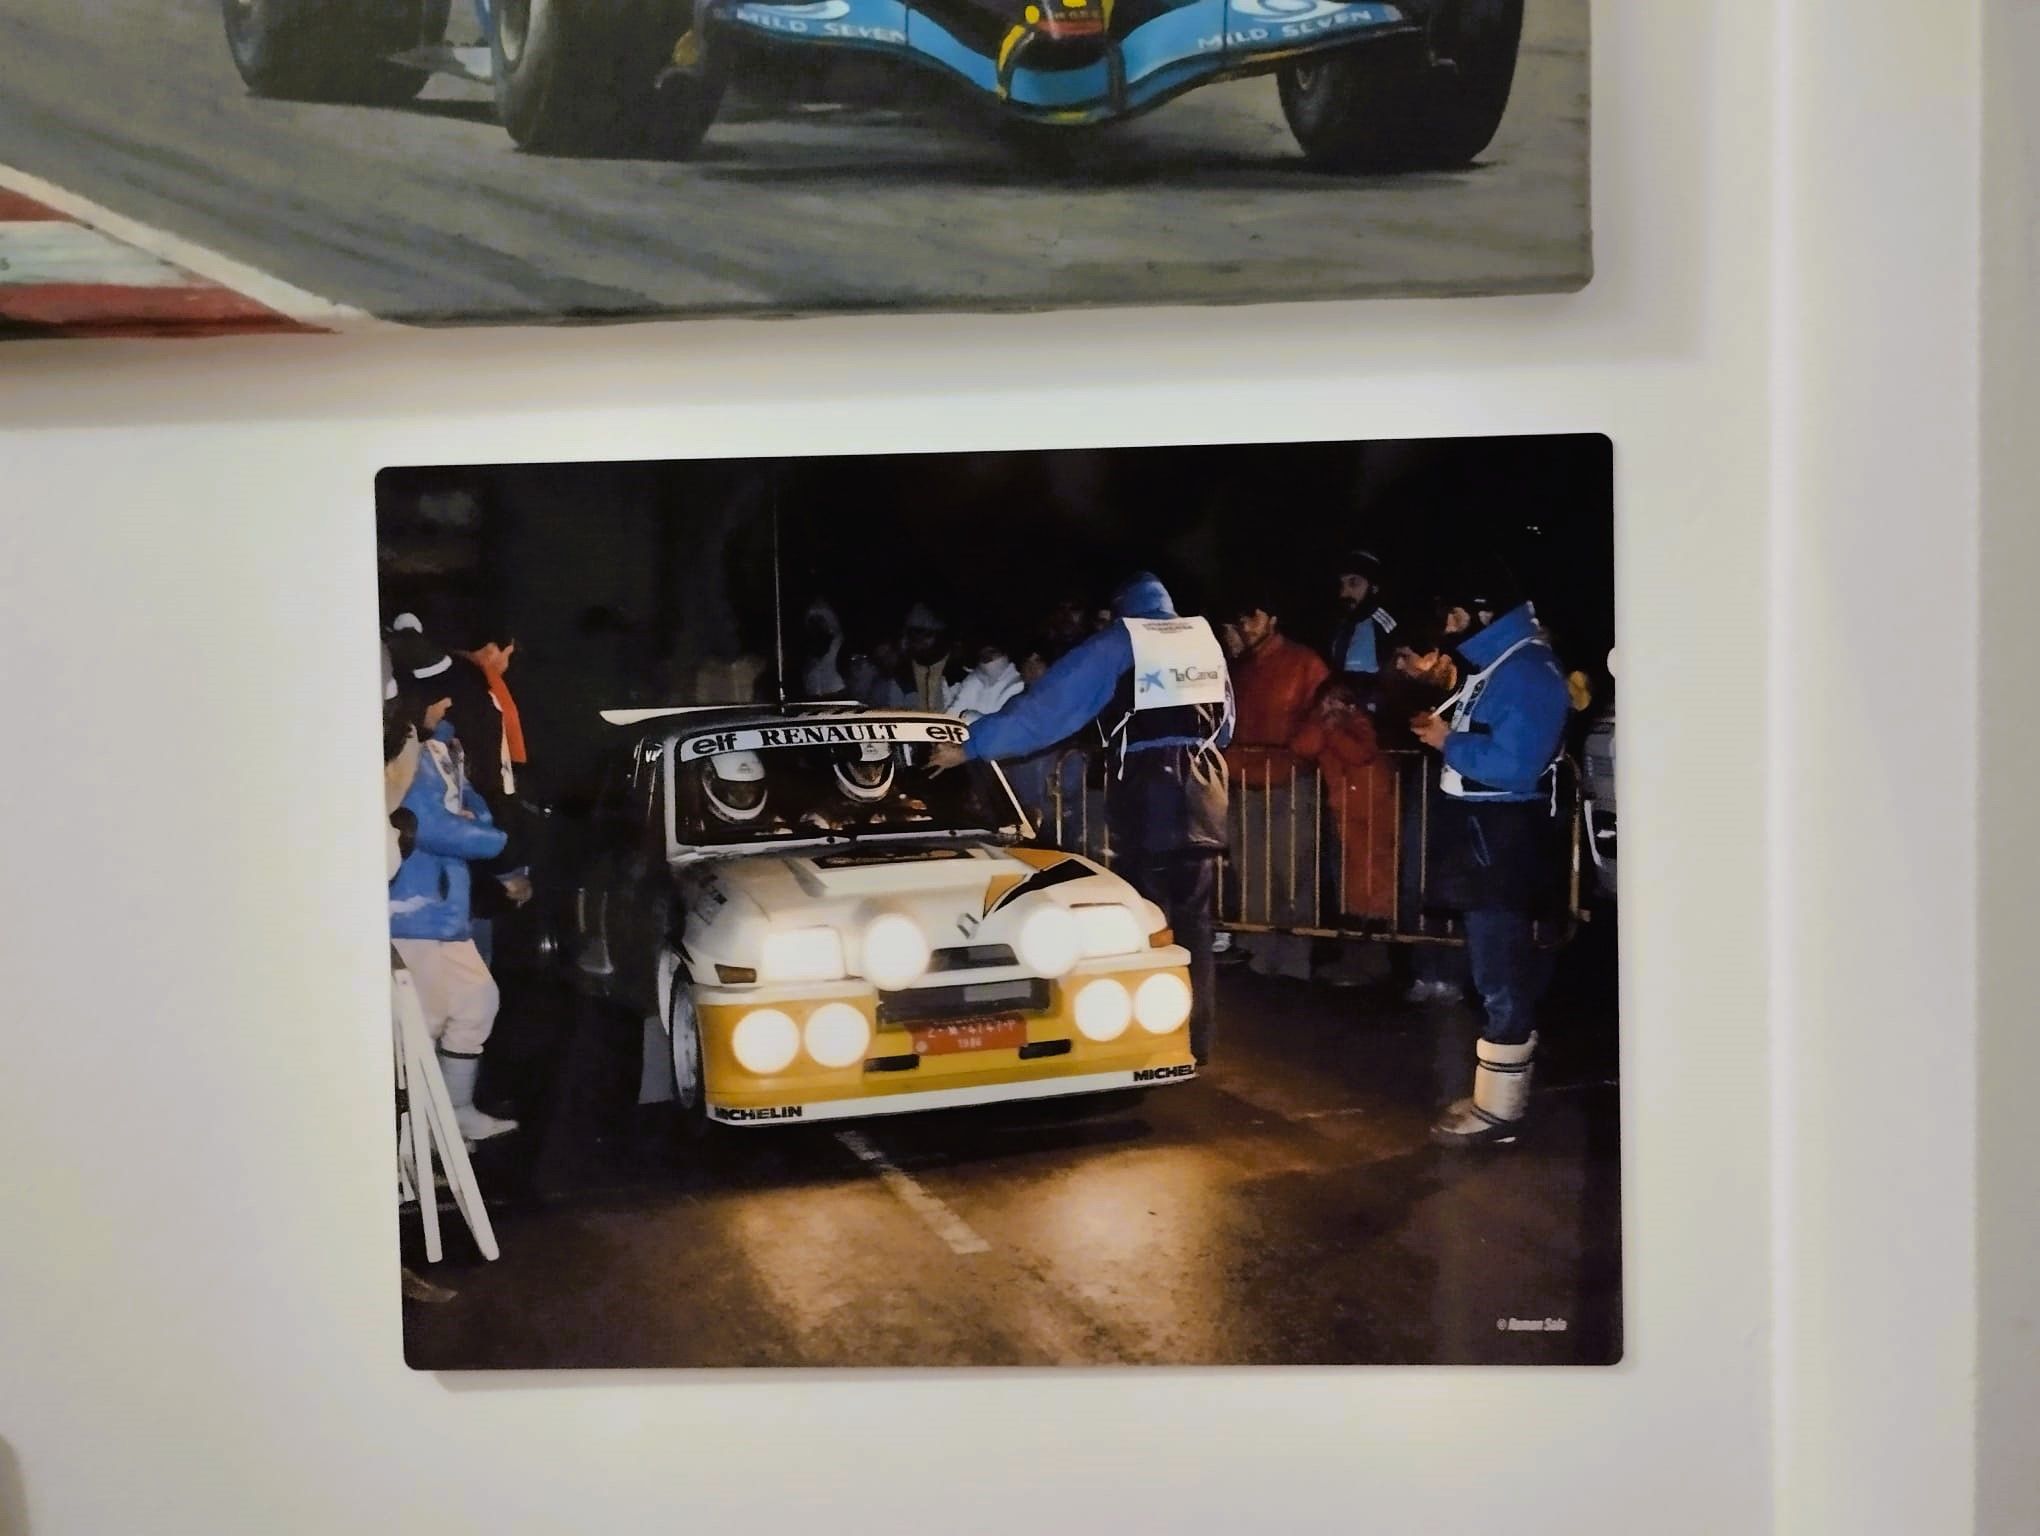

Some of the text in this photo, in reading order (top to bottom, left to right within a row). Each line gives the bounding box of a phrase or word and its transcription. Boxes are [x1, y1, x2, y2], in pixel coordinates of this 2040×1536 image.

[736, 8, 907, 43] MILD SEVEN
[1199, 10, 1373, 49] MILD SEVEN
[692, 724, 964, 754] elf RENAULT elf
